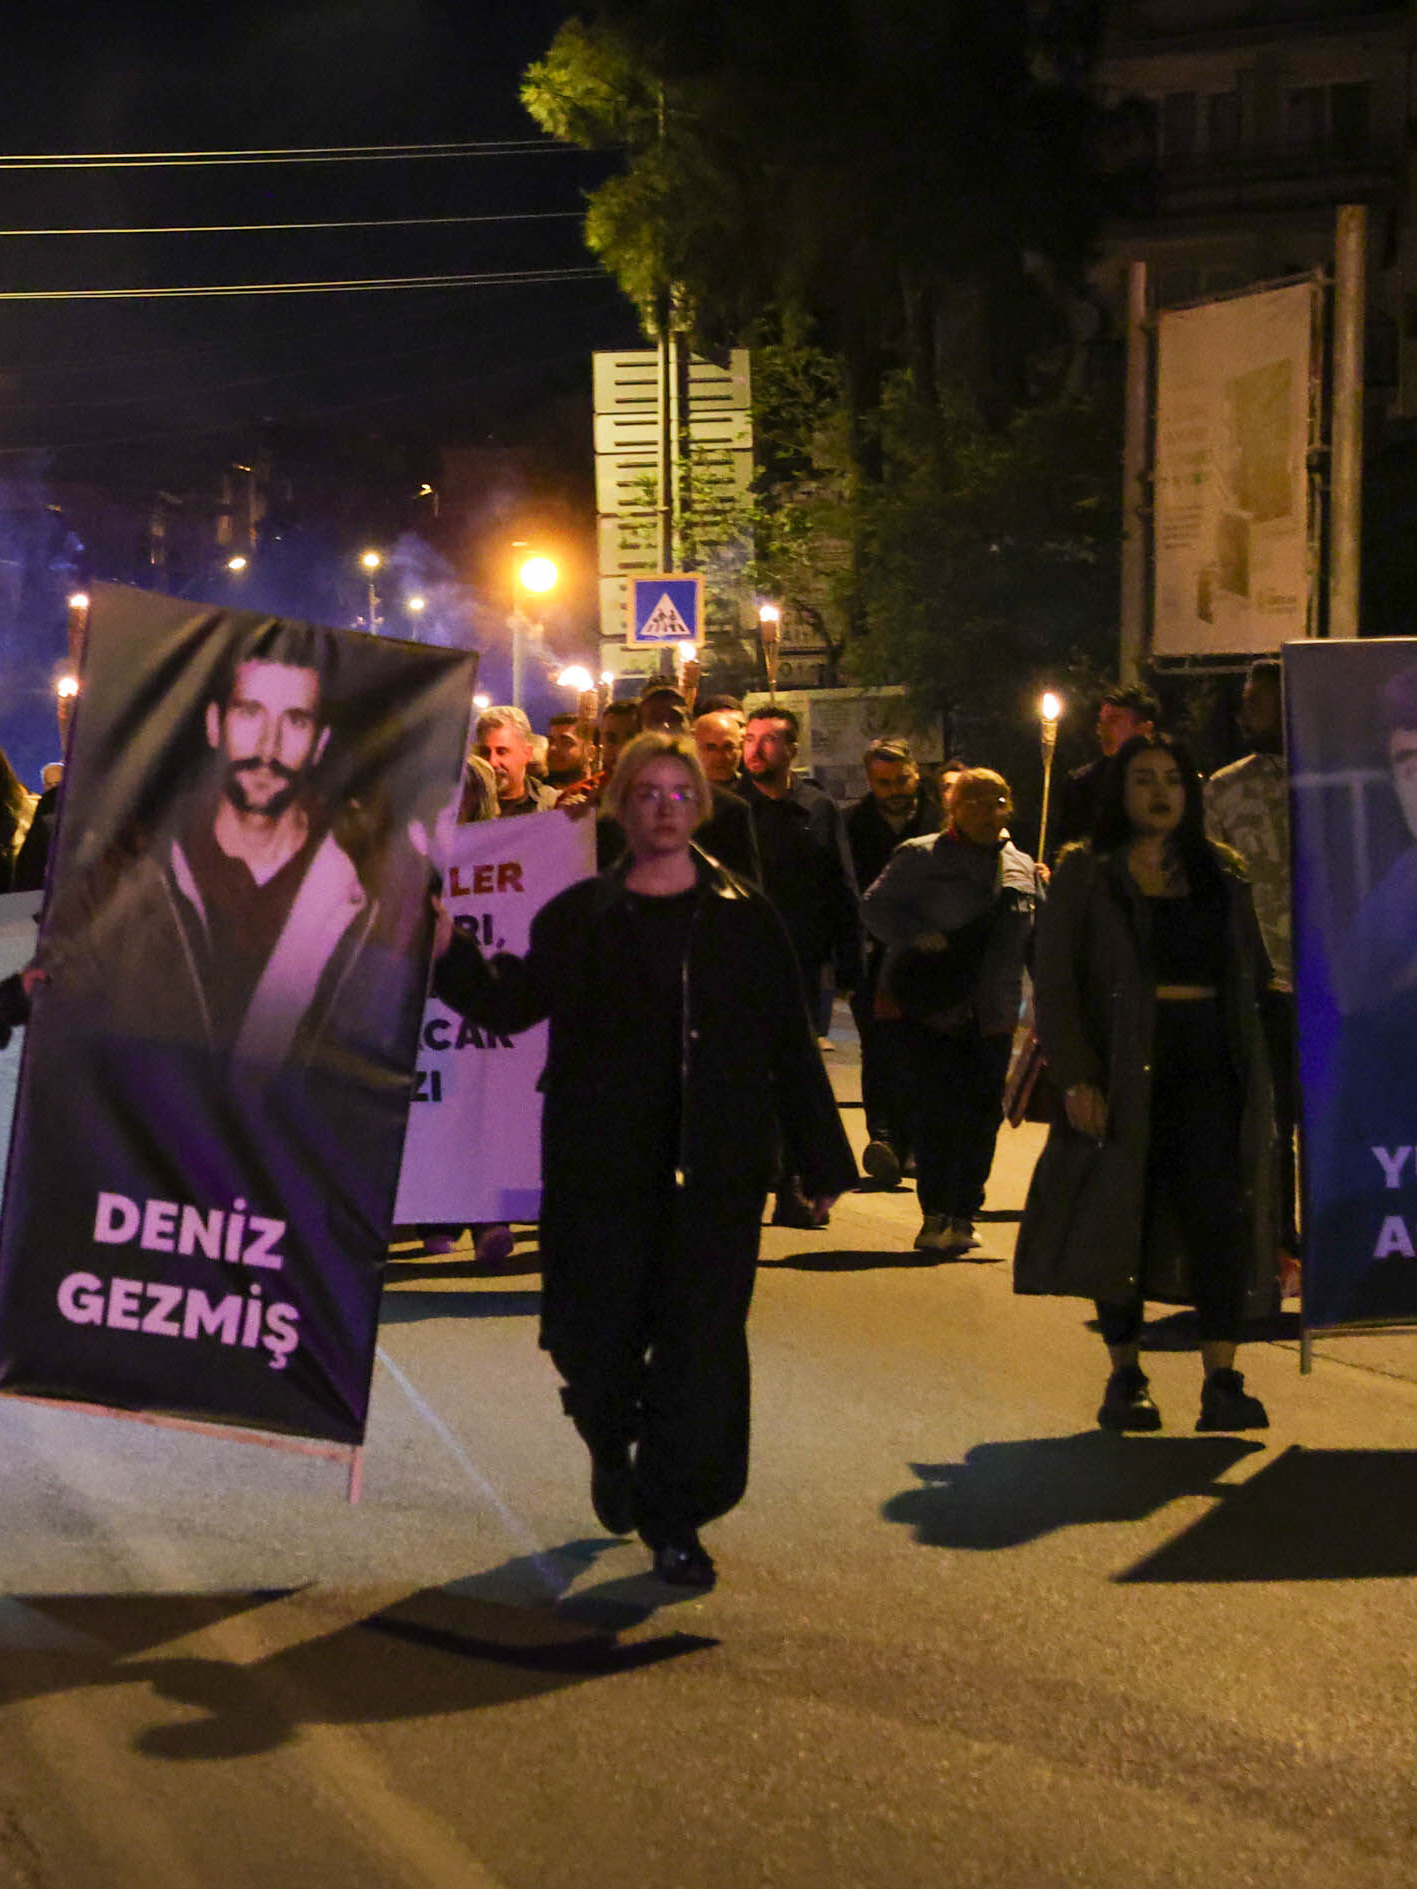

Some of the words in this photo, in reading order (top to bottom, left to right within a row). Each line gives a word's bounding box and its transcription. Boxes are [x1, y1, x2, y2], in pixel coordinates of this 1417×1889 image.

[449, 863, 525, 897] LER
[1370, 1145, 1417, 1189] Y
[93, 1191, 287, 1270] DENİZ
[56, 1271, 301, 1370] GEZMİŞ
